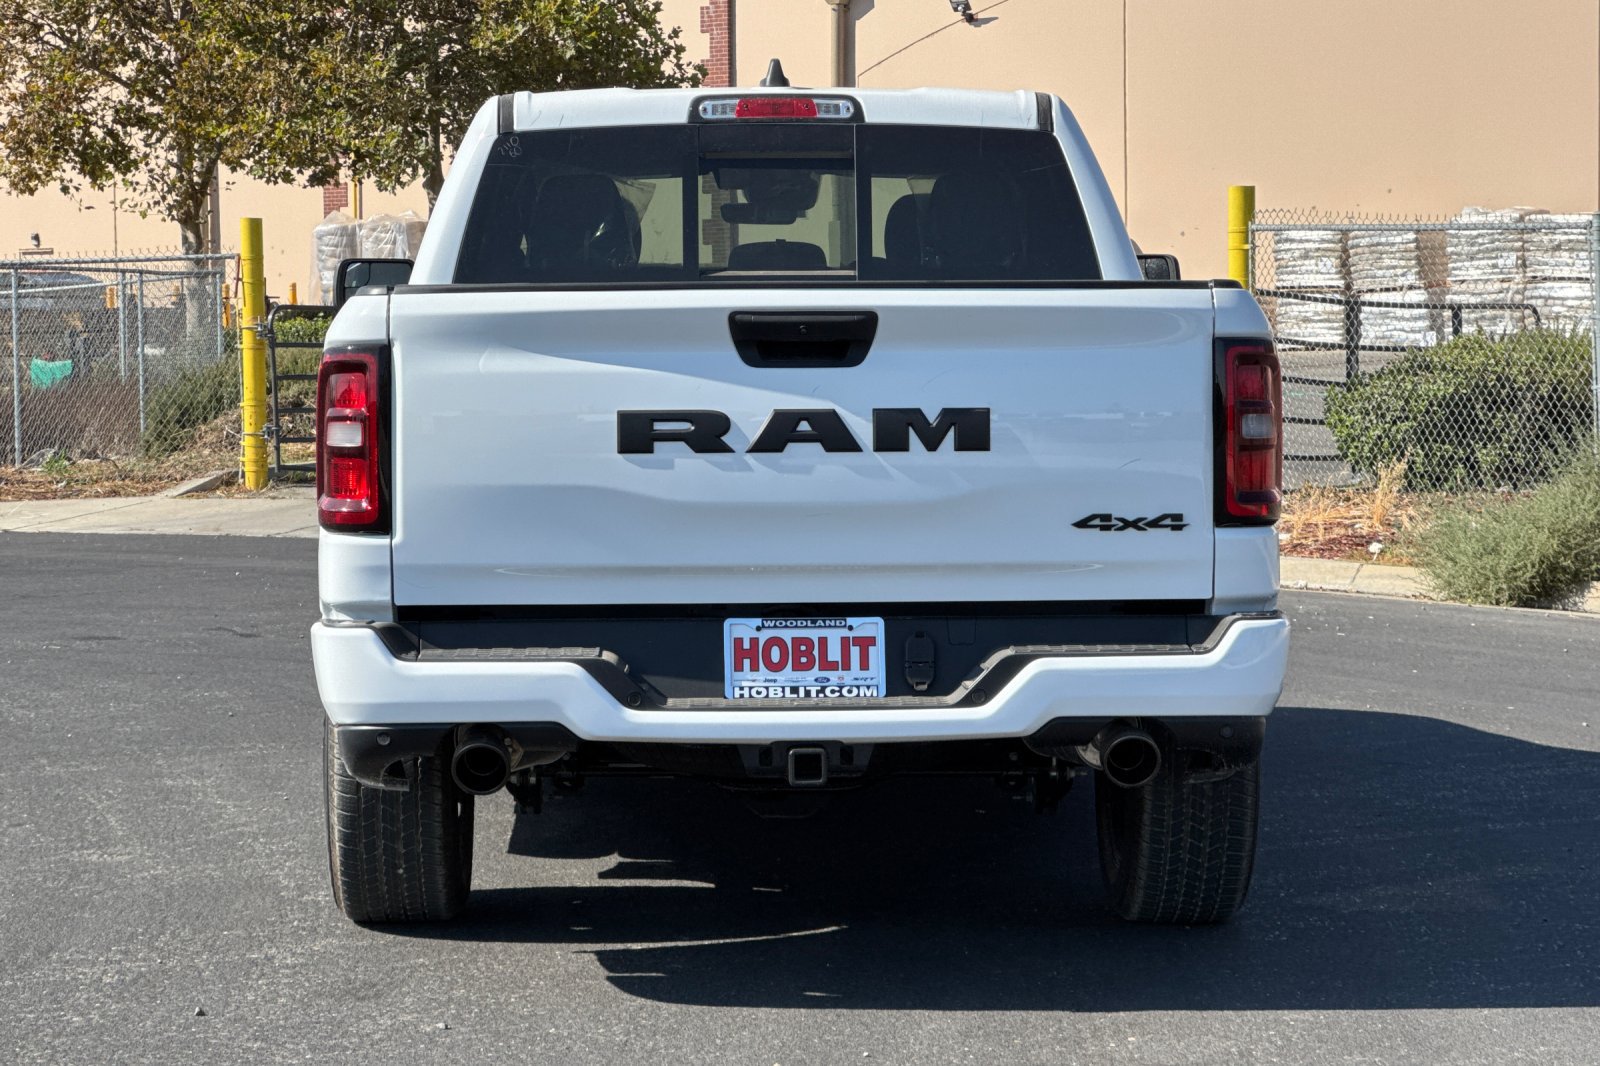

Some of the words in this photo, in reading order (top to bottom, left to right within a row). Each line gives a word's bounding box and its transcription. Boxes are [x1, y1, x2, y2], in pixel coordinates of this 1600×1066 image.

[617, 407, 991, 454] RAM
[1071, 513, 1190, 532] 4x4
[762, 619, 846, 628] WOODLAND
[733, 636, 877, 672] HOBLIT
[733, 686, 878, 698] HOBLIT.COM
